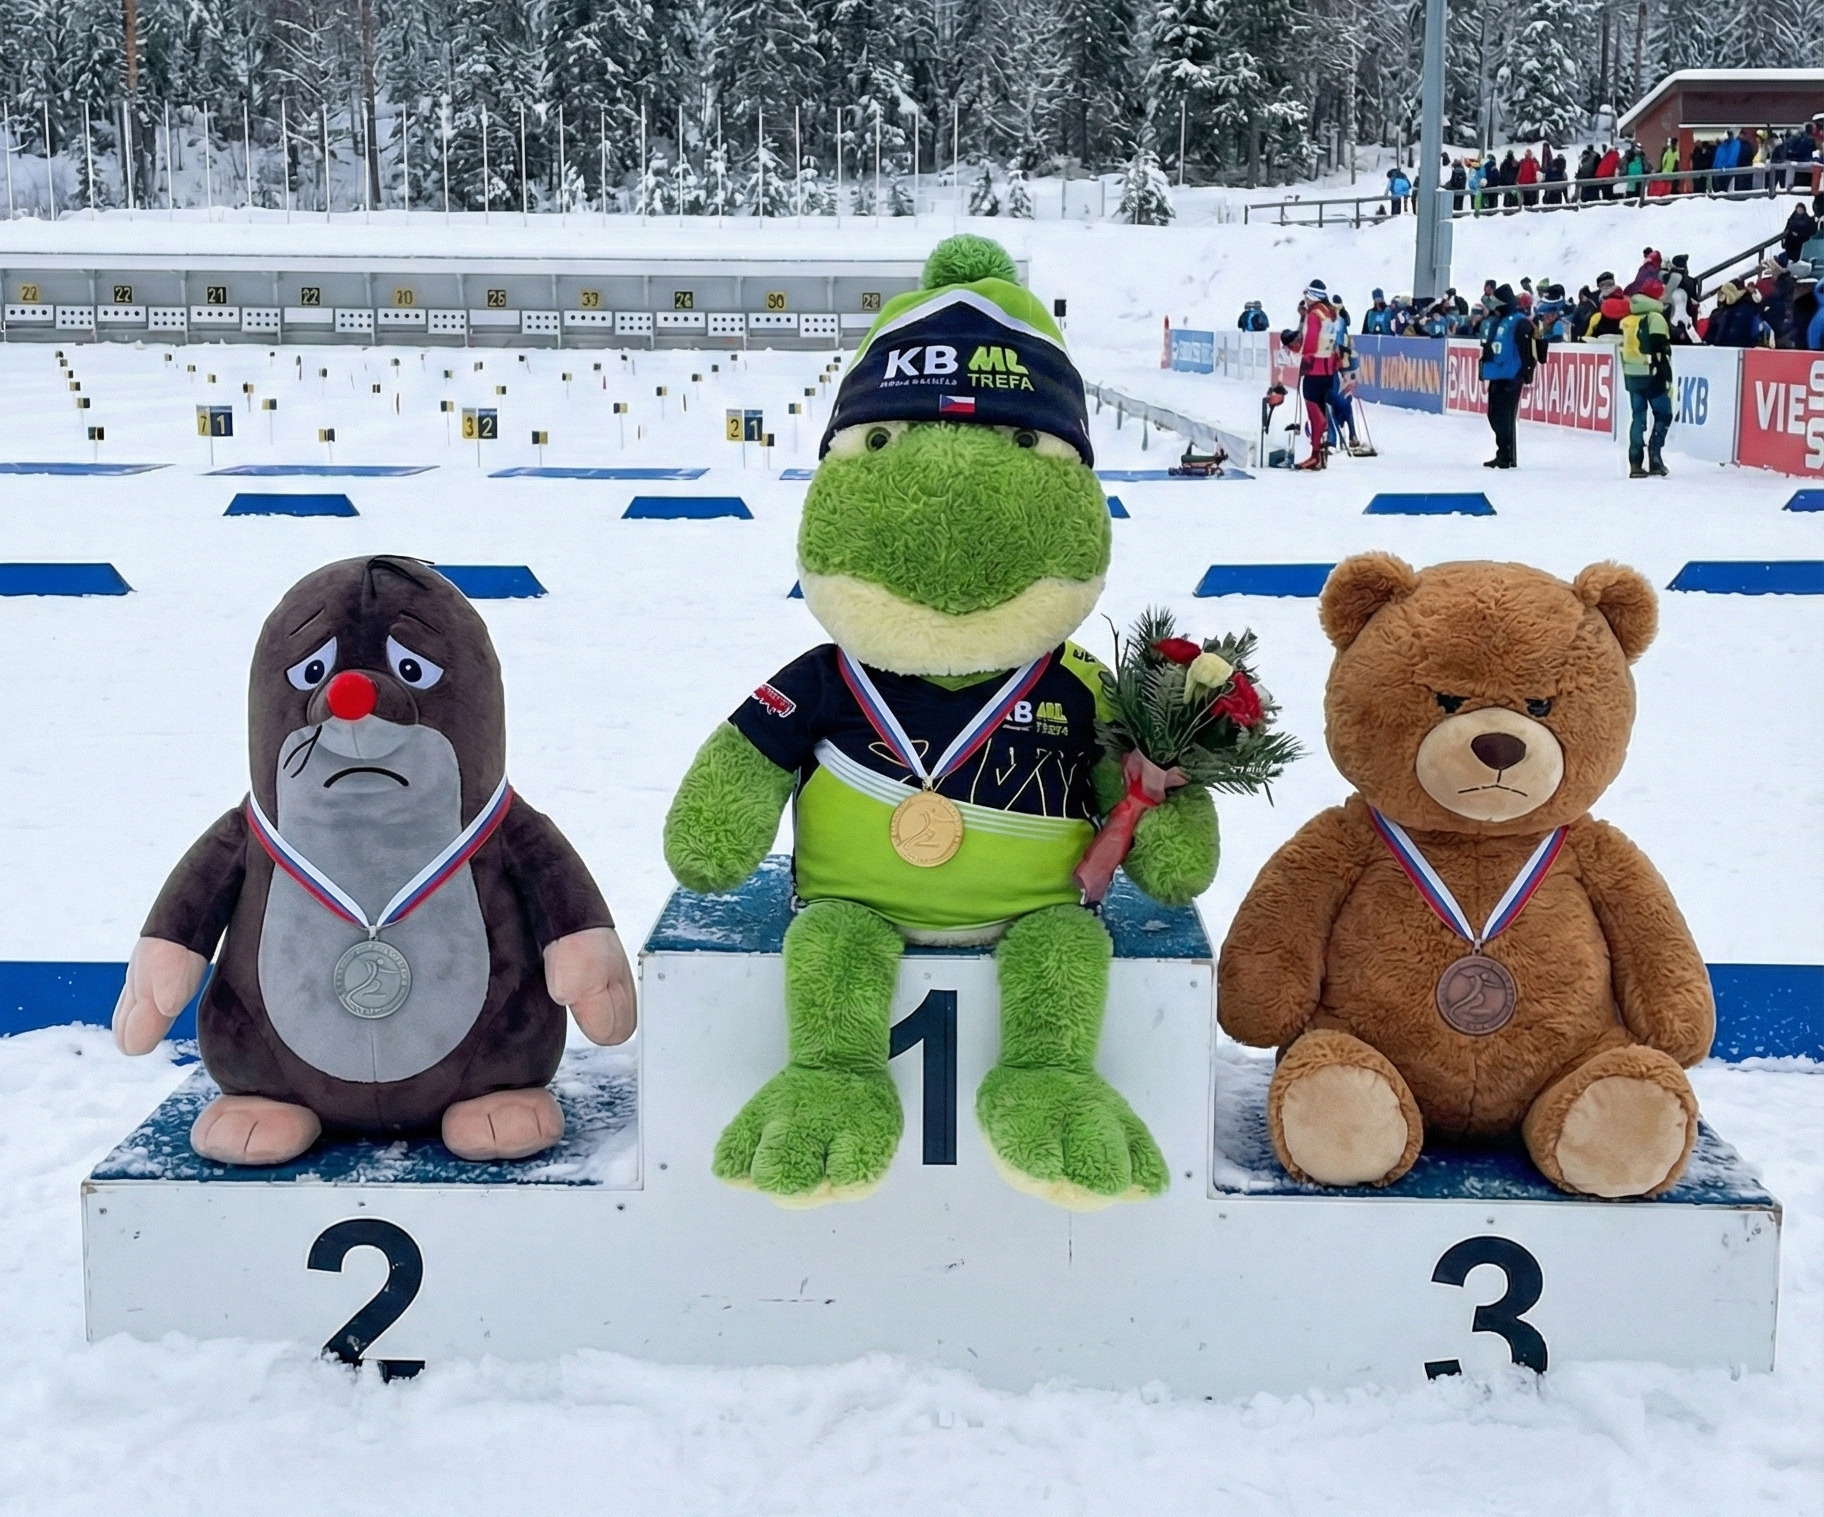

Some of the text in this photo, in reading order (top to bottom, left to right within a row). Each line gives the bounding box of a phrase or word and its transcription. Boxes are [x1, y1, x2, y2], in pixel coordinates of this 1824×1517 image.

[208, 287, 224, 303] 21
[884, 345, 959, 379] KB
[967, 373, 1035, 392] TREFA
[1675, 376, 1709, 426] KB
[1005, 700, 1033, 723] B
[888, 989, 957, 1165] 1
[307, 1218, 426, 1384] 2
[1424, 1235, 1548, 1381] 3
